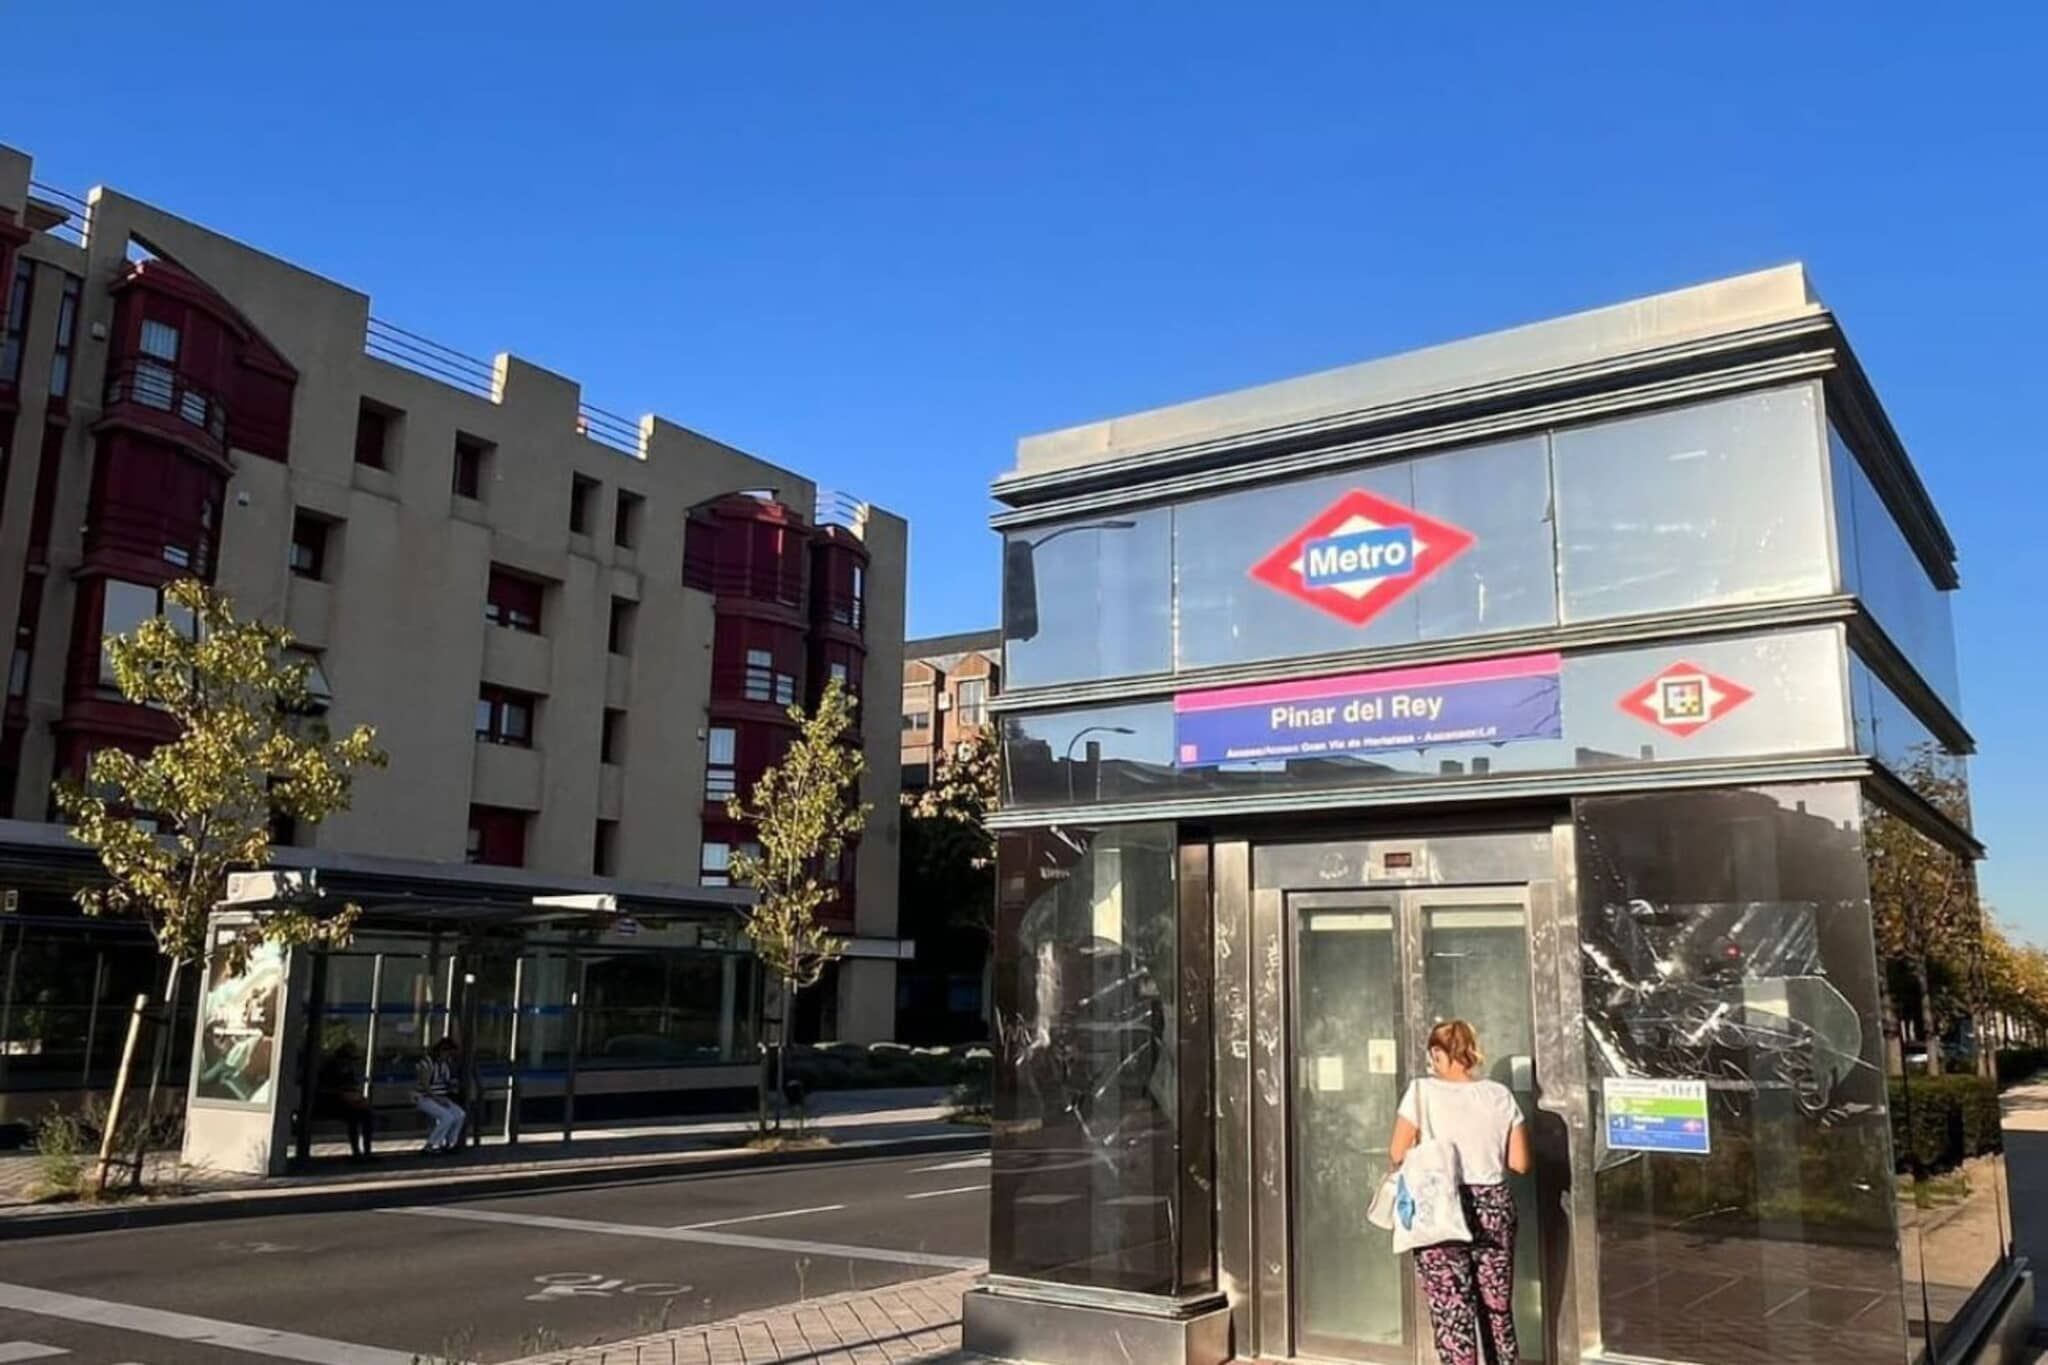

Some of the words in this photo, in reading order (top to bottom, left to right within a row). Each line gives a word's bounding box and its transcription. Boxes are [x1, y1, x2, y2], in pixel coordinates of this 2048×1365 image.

[1309, 541, 1406, 577] Metro
[1271, 705, 1336, 729] Pinar
[1343, 698, 1382, 723] del
[1391, 695, 1443, 720] Rey
